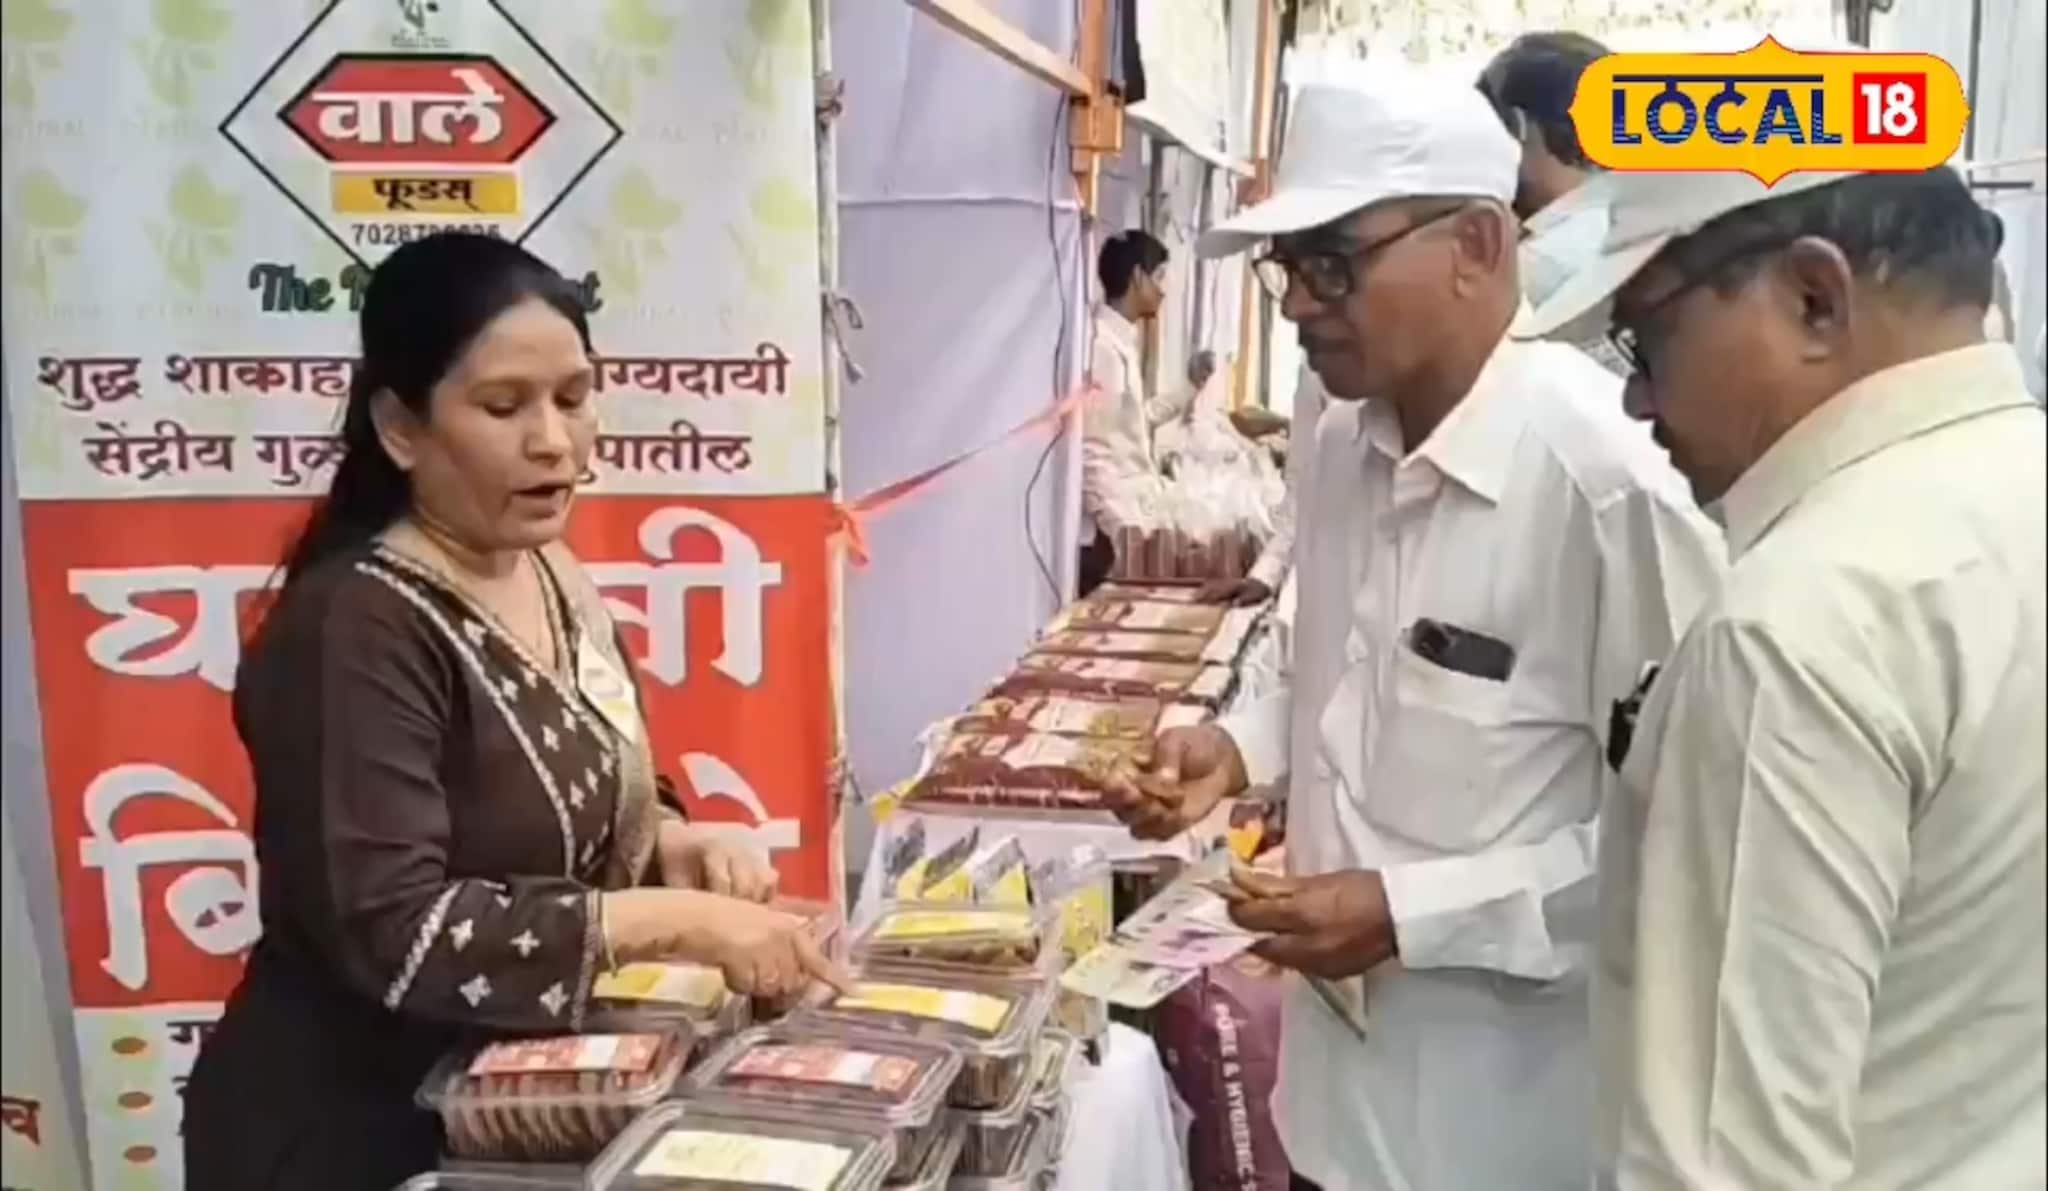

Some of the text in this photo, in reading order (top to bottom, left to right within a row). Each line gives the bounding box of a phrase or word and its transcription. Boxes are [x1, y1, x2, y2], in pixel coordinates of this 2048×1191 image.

[312, 70, 504, 146] वाले
[372, 178, 486, 212] फूडस्
[249, 263, 334, 312] The
[37, 355, 142, 411] शुद्ध
[81, 419, 236, 480] सेंद्रीय
